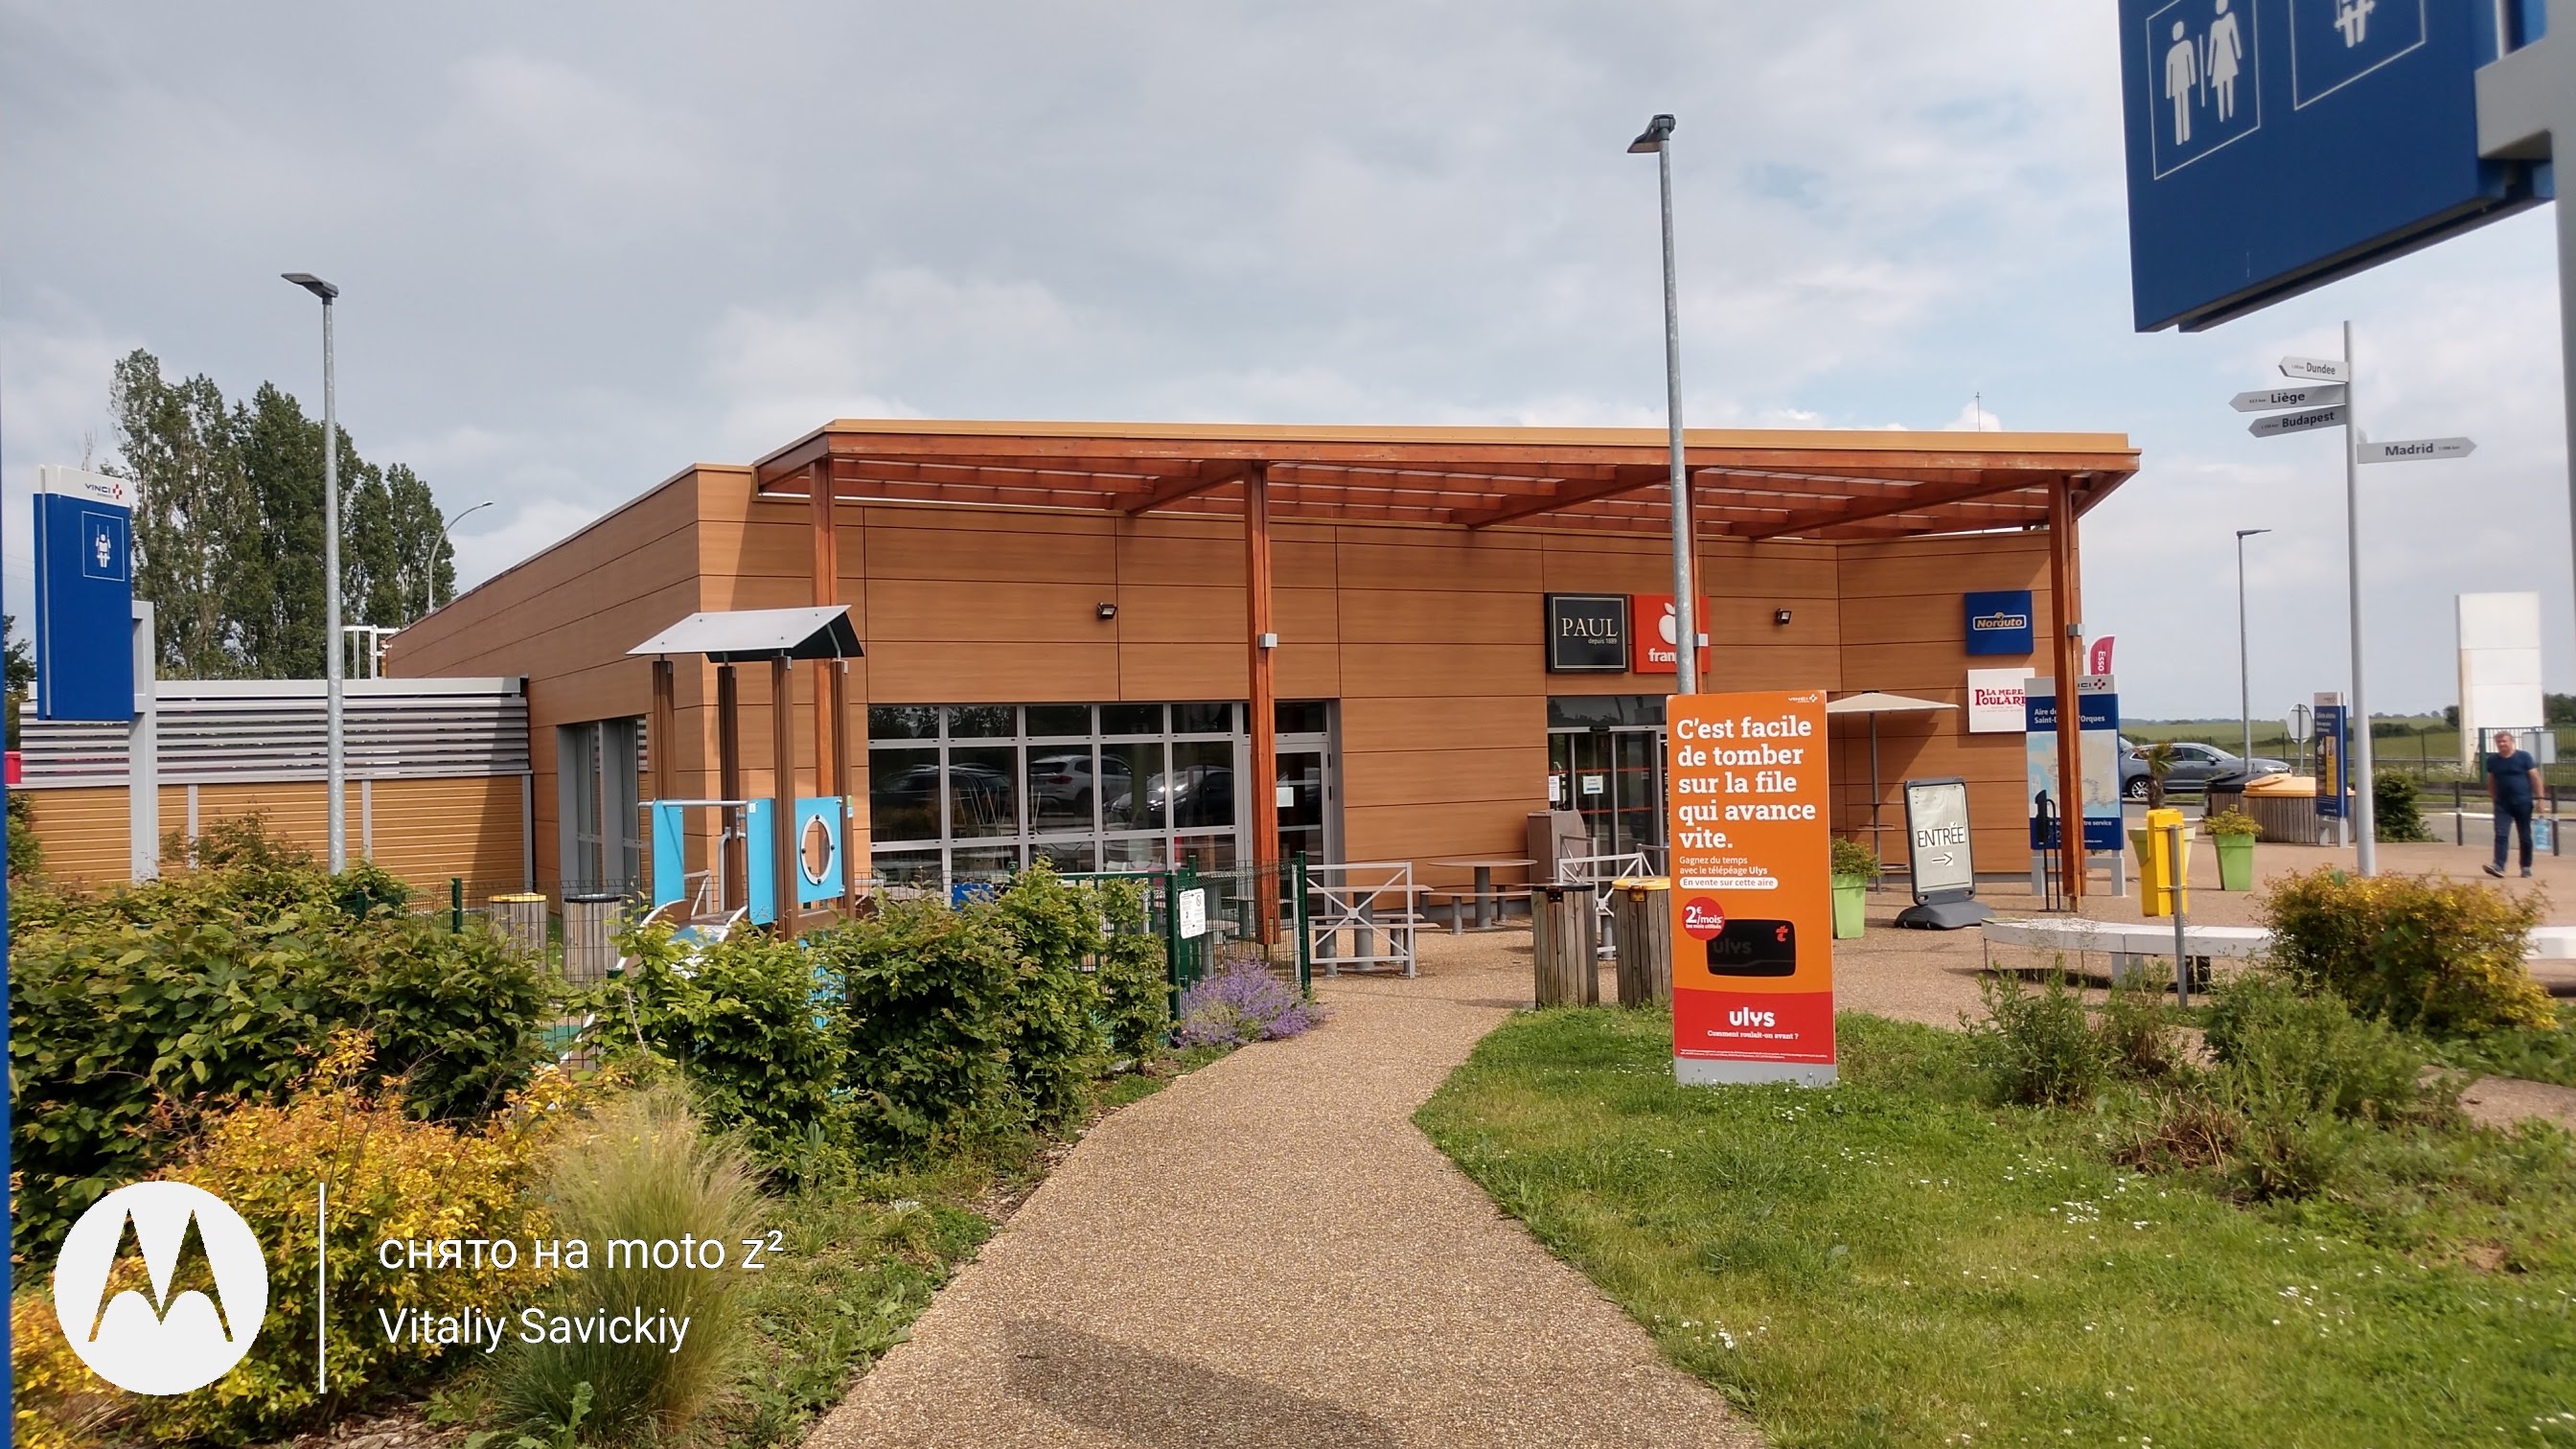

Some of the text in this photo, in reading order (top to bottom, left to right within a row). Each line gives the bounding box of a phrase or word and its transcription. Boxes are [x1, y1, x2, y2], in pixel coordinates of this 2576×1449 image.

[2306, 362, 2335, 375] Dundee
[2270, 392, 2306, 404] Liège
[2282, 411, 2334, 427] Budapest
[2384, 443, 2434, 456] Madrid
[84, 483, 111, 494] VINCI
[1561, 618, 1619, 637] PAUL
[1977, 618, 2023, 628] Norauto
[2097, 651, 2106, 672] Esso
[1677, 715, 1812, 739] C'est facile
[1677, 744, 1804, 767] de tomber
[1678, 777, 1719, 794] sur
[1725, 771, 1749, 794] la
[1756, 770, 1797, 793] file
[1678, 799, 1816, 826] qui avance
[1679, 827, 1734, 848] vite.
[1917, 822, 1966, 848] ENTRÉE
[1679, 856, 1709, 865] Gagnez
[1710, 856, 1721, 864] du
[1708, 865, 1748, 876] télépéage
[1748, 865, 1768, 876] Ulys
[1713, 938, 1752, 954] ulys
[1729, 1006, 1776, 1027] ulys
[1740, 1030, 1774, 1039] roulait-on
